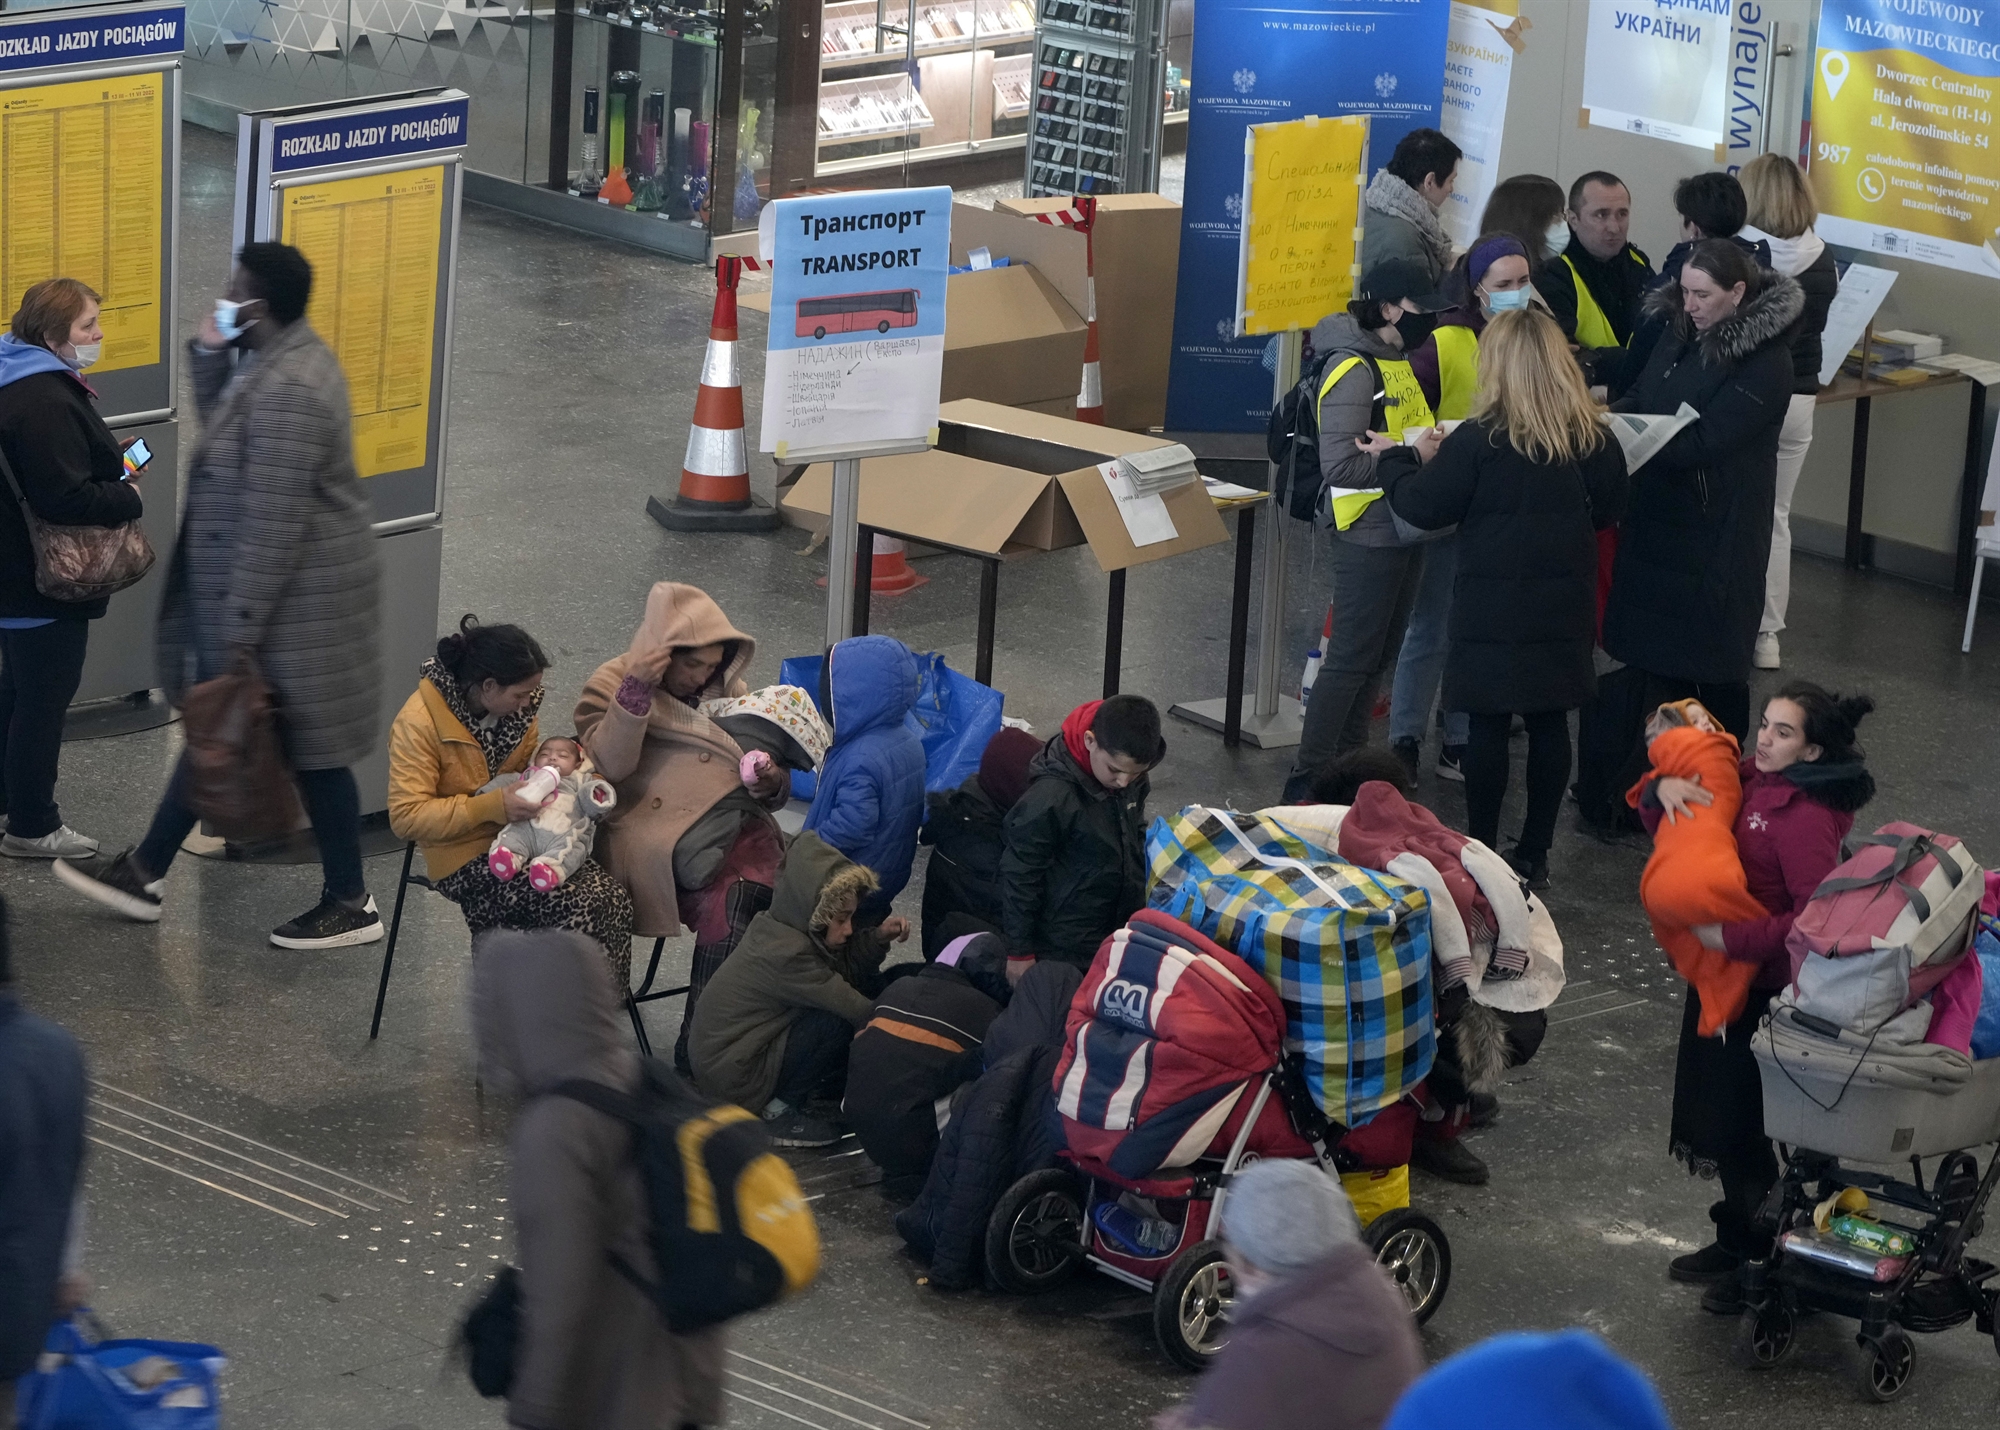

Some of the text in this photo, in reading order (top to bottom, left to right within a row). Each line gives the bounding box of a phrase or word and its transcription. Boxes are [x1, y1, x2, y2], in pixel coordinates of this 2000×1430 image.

[1655, 0, 1730, 16] ДЯНАМ
[1879, 0, 1985, 27] WOJEWODY
[0, 18, 177, 58] OZKŁAD JAZDY POCIĄGÓW
[1262, 20, 1376, 34] www.mazowieckie.pl
[1614, 10, 1701, 45] УКРАЇНИ
[1443, 77, 1482, 97] ВАНОГО
[1876, 64, 1992, 103] Dworzec Centralny
[1197, 97, 1291, 107] WOJEWODA MAZOWIECKI
[1337, 101, 1432, 111] WOJEWODA MAZOWIECKI
[1873, 88, 1992, 126] Hala dworca (H-14)
[281, 112, 460, 158] ROZKŁAD JAZDY POCIĄGÓW
[1871, 114, 1989, 149] al. Jerozolimskie 54
[1817, 142, 1852, 165] 987
[1866, 152, 2000, 191] całodobowa infolinia pomocy
[1891, 175, 1989, 205] terenie województwa
[1902, 198, 1972, 222] mazowieckiego
[801, 210, 926, 241] Транспорт
[1189, 222, 1231, 230] WOJEWODA
[801, 247, 922, 276] TRANSPORT
[1279, 260, 1326, 274] ПЕРОН 3
[1256, 278, 1302, 296] БАГАТО
[797, 344, 863, 366] НАДАЖИН
[1391, 383, 1422, 411] УКРА
